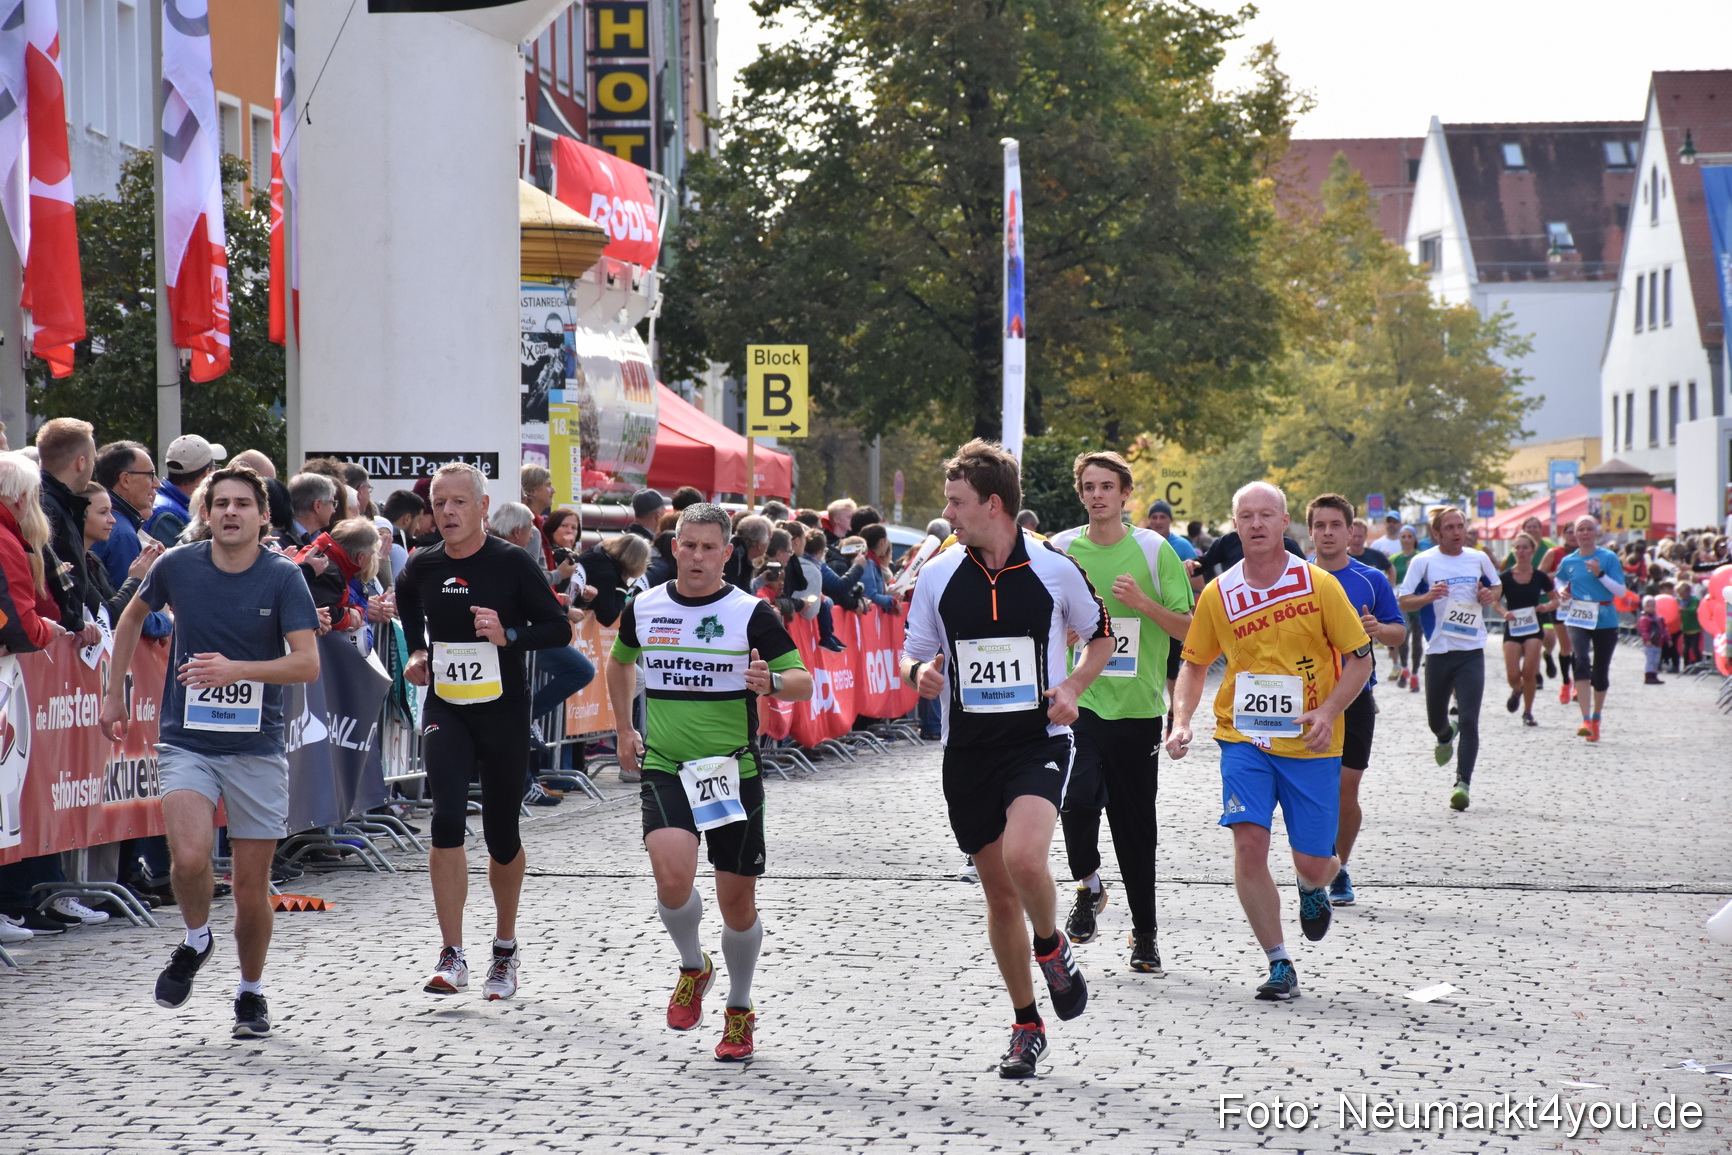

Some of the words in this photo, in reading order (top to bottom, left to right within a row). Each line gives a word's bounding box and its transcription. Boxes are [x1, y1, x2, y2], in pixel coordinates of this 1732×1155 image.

[534, 344, 548, 355] CUP
[754, 349, 801, 365] Block
[763, 373, 793, 417] B
[552, 418, 569, 436] 18.
[1161, 468, 1188, 478] Block
[1165, 481, 1183, 507] C
[1634, 504, 1647, 522] D
[441, 586, 469, 595] skinfit
[1233, 616, 1271, 640] MAX
[1273, 601, 1320, 623] BÖGL
[1448, 610, 1477, 626] 2427
[1513, 616, 1534, 626] 2798
[1572, 609, 1594, 620] 2753
[647, 636, 680, 645] OBI
[446, 662, 484, 682] 412
[646, 656, 733, 672] Laufteam
[969, 659, 1020, 684] 2411
[662, 672, 713, 687] Fürth
[197, 680, 253, 705] 2499
[981, 691, 1015, 700] Matthias
[1243, 693, 1292, 714] 2615
[211, 710, 236, 720] Stefan
[1253, 718, 1283, 727] Andreas
[51, 770, 102, 811] schönsten
[695, 775, 730, 802] 2776
